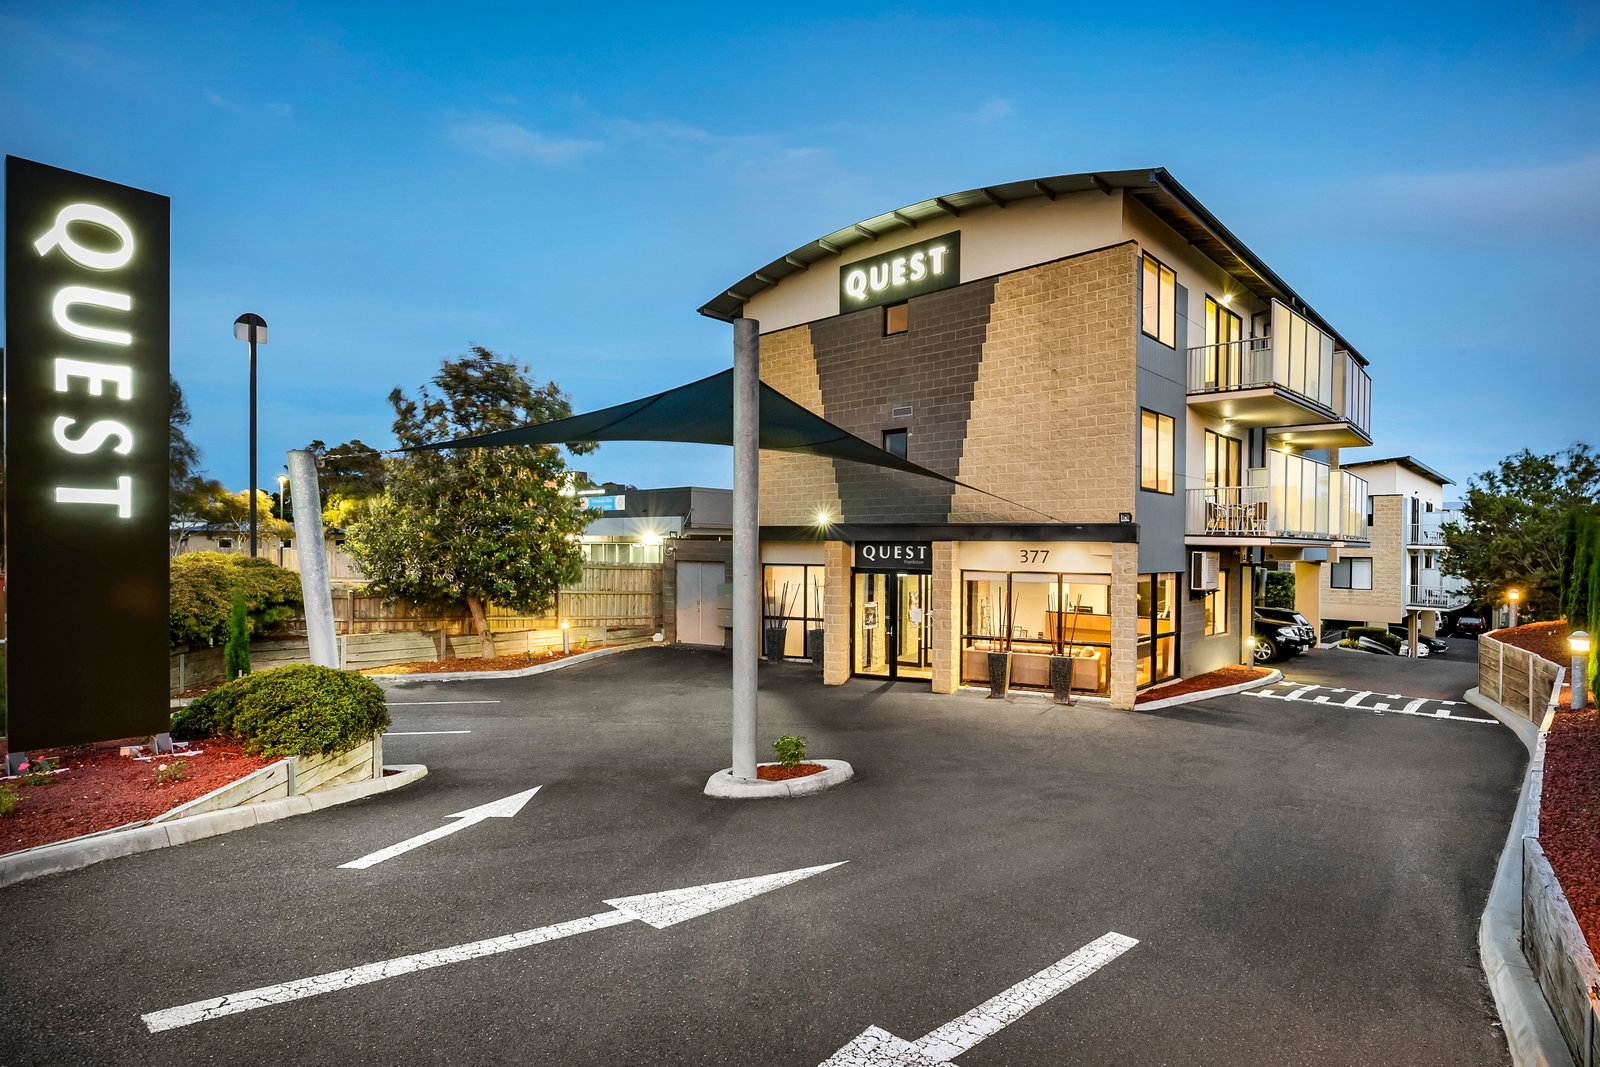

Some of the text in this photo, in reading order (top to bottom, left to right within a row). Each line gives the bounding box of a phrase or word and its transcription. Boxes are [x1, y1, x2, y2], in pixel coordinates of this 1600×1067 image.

[846, 246, 947, 300] QUEST
[34, 204, 133, 519] QUEST
[862, 545, 927, 561] QUEST
[1020, 549, 1050, 563] 377
